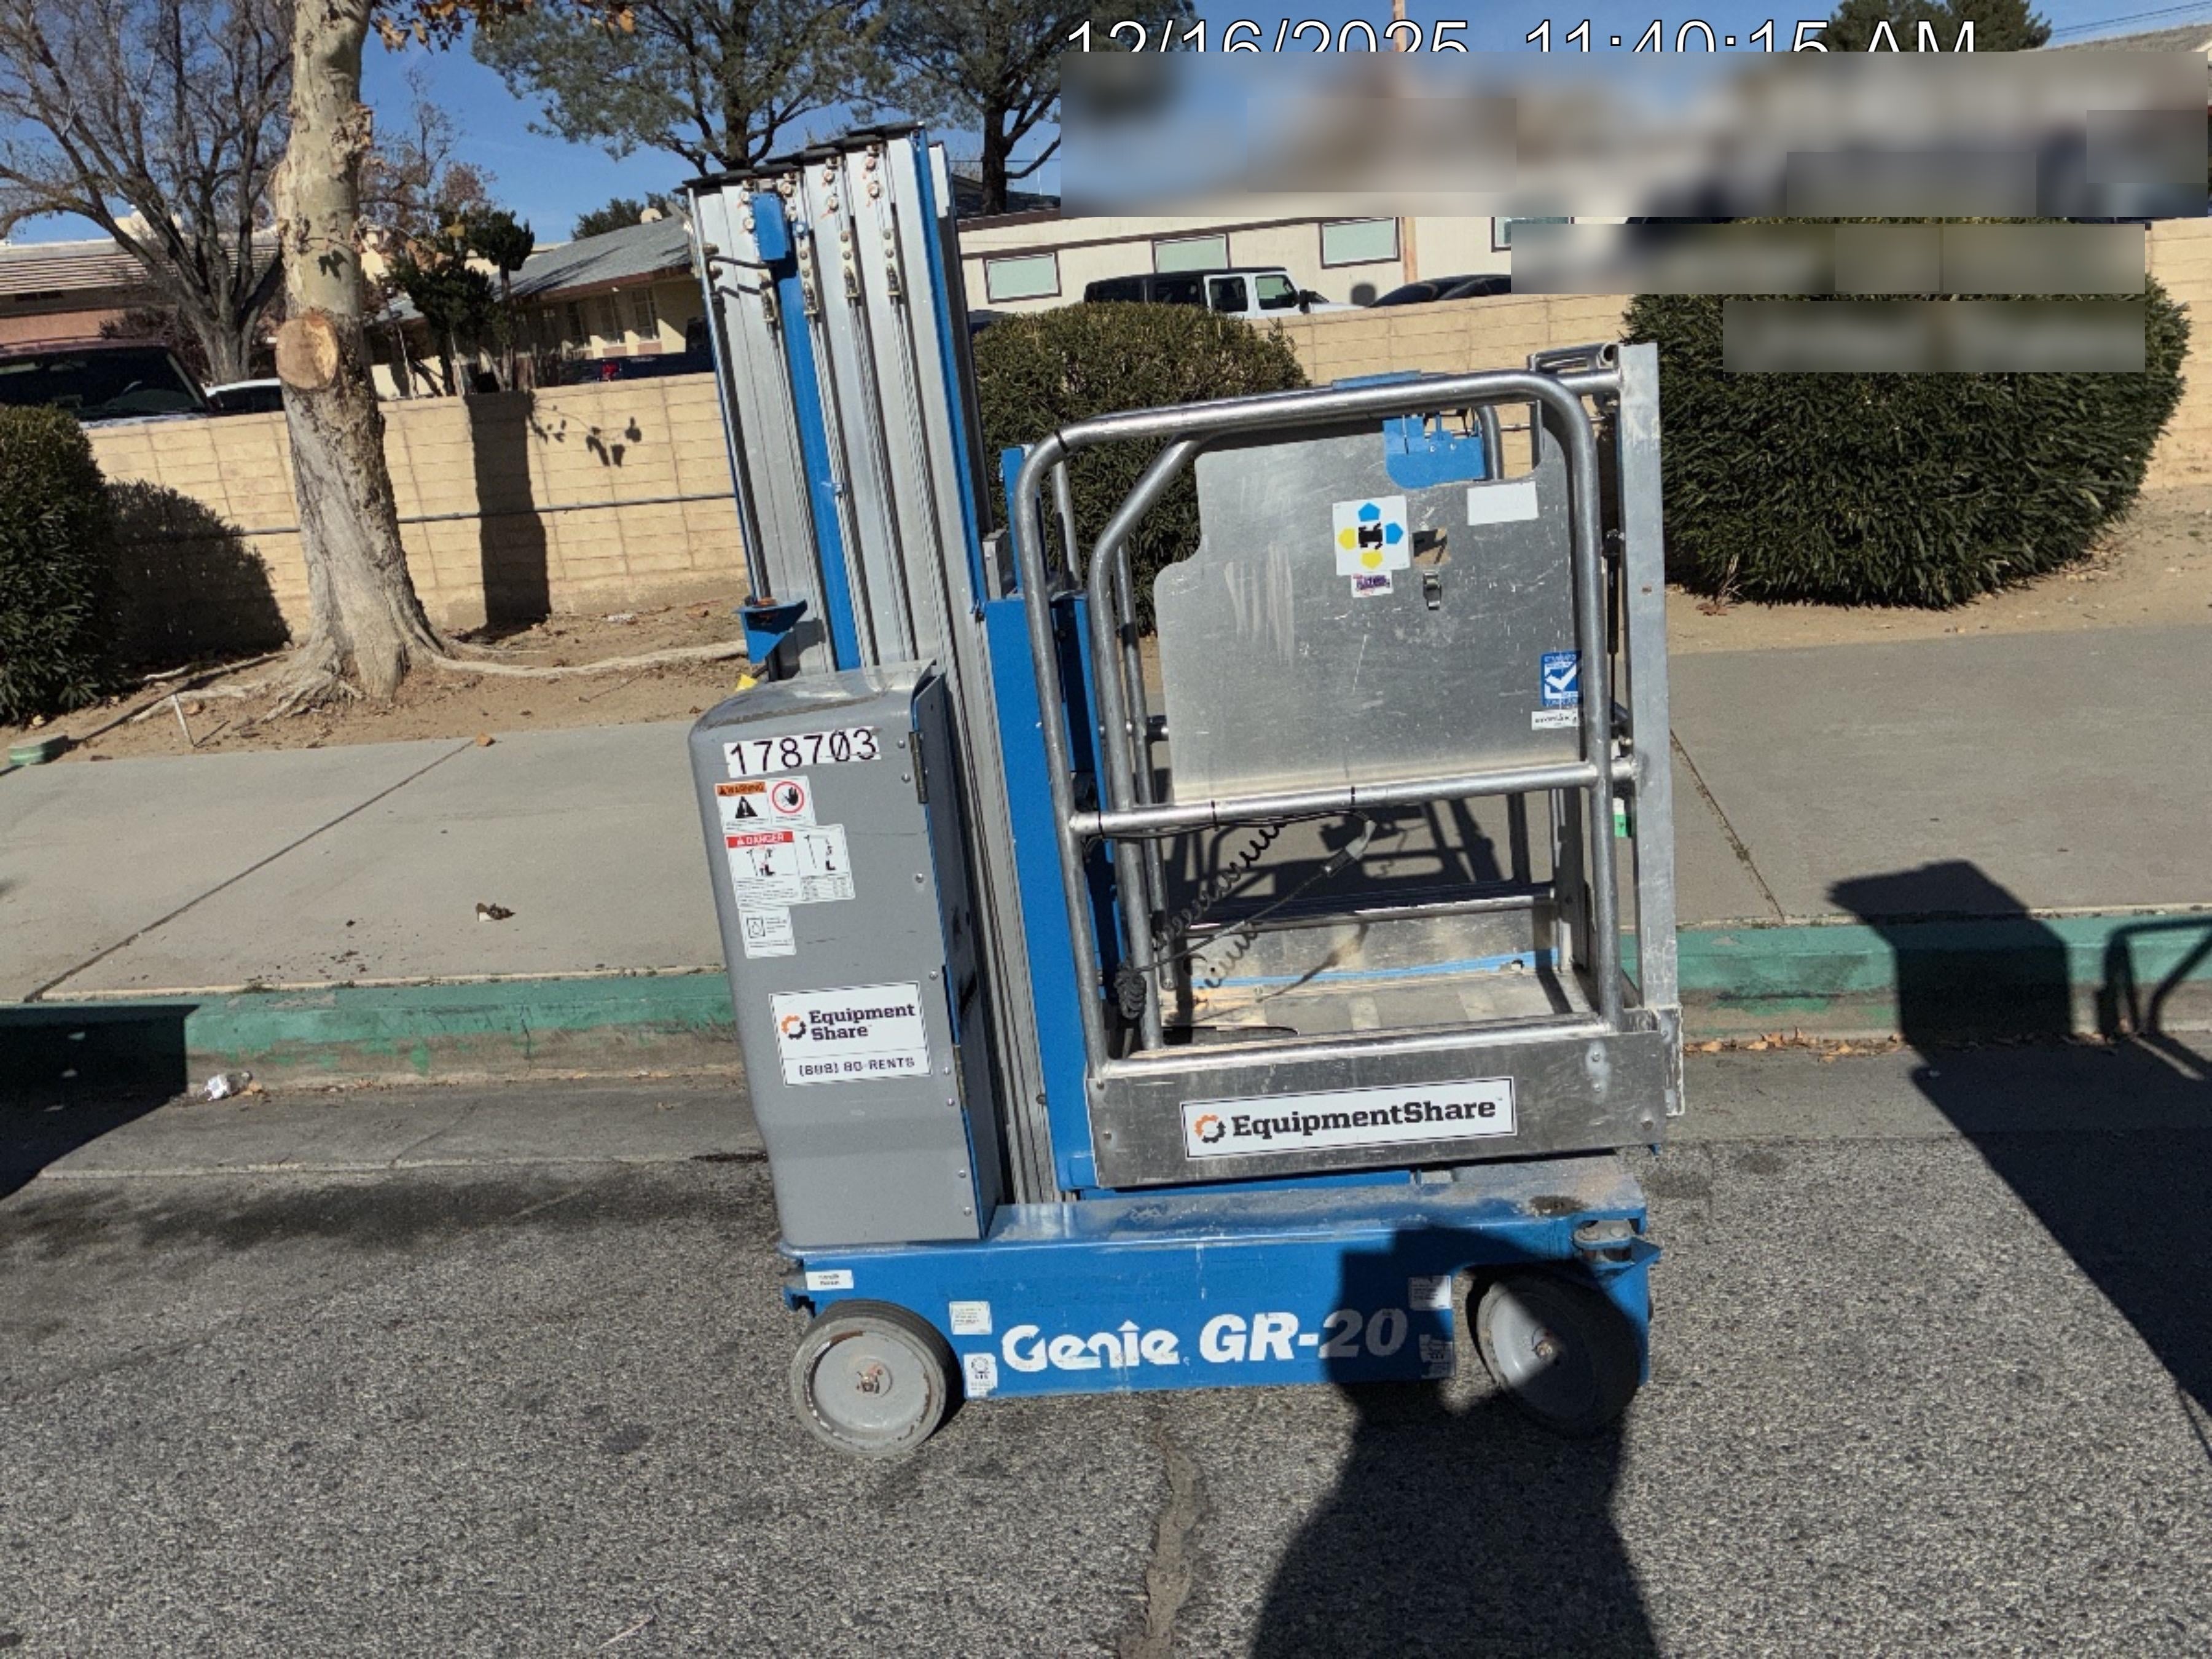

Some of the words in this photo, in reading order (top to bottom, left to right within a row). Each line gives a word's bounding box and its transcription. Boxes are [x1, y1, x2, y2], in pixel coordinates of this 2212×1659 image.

[730, 729, 876, 775] 178703
[745, 833, 784, 845] DANGER
[809, 1003, 916, 1025] Equipment
[811, 1025, 868, 1041] Share
[1231, 1100, 1496, 1140] EquipmentShare
[1002, 1320, 1181, 1373] Genie
[1199, 1308, 1409, 1363] GR-20
